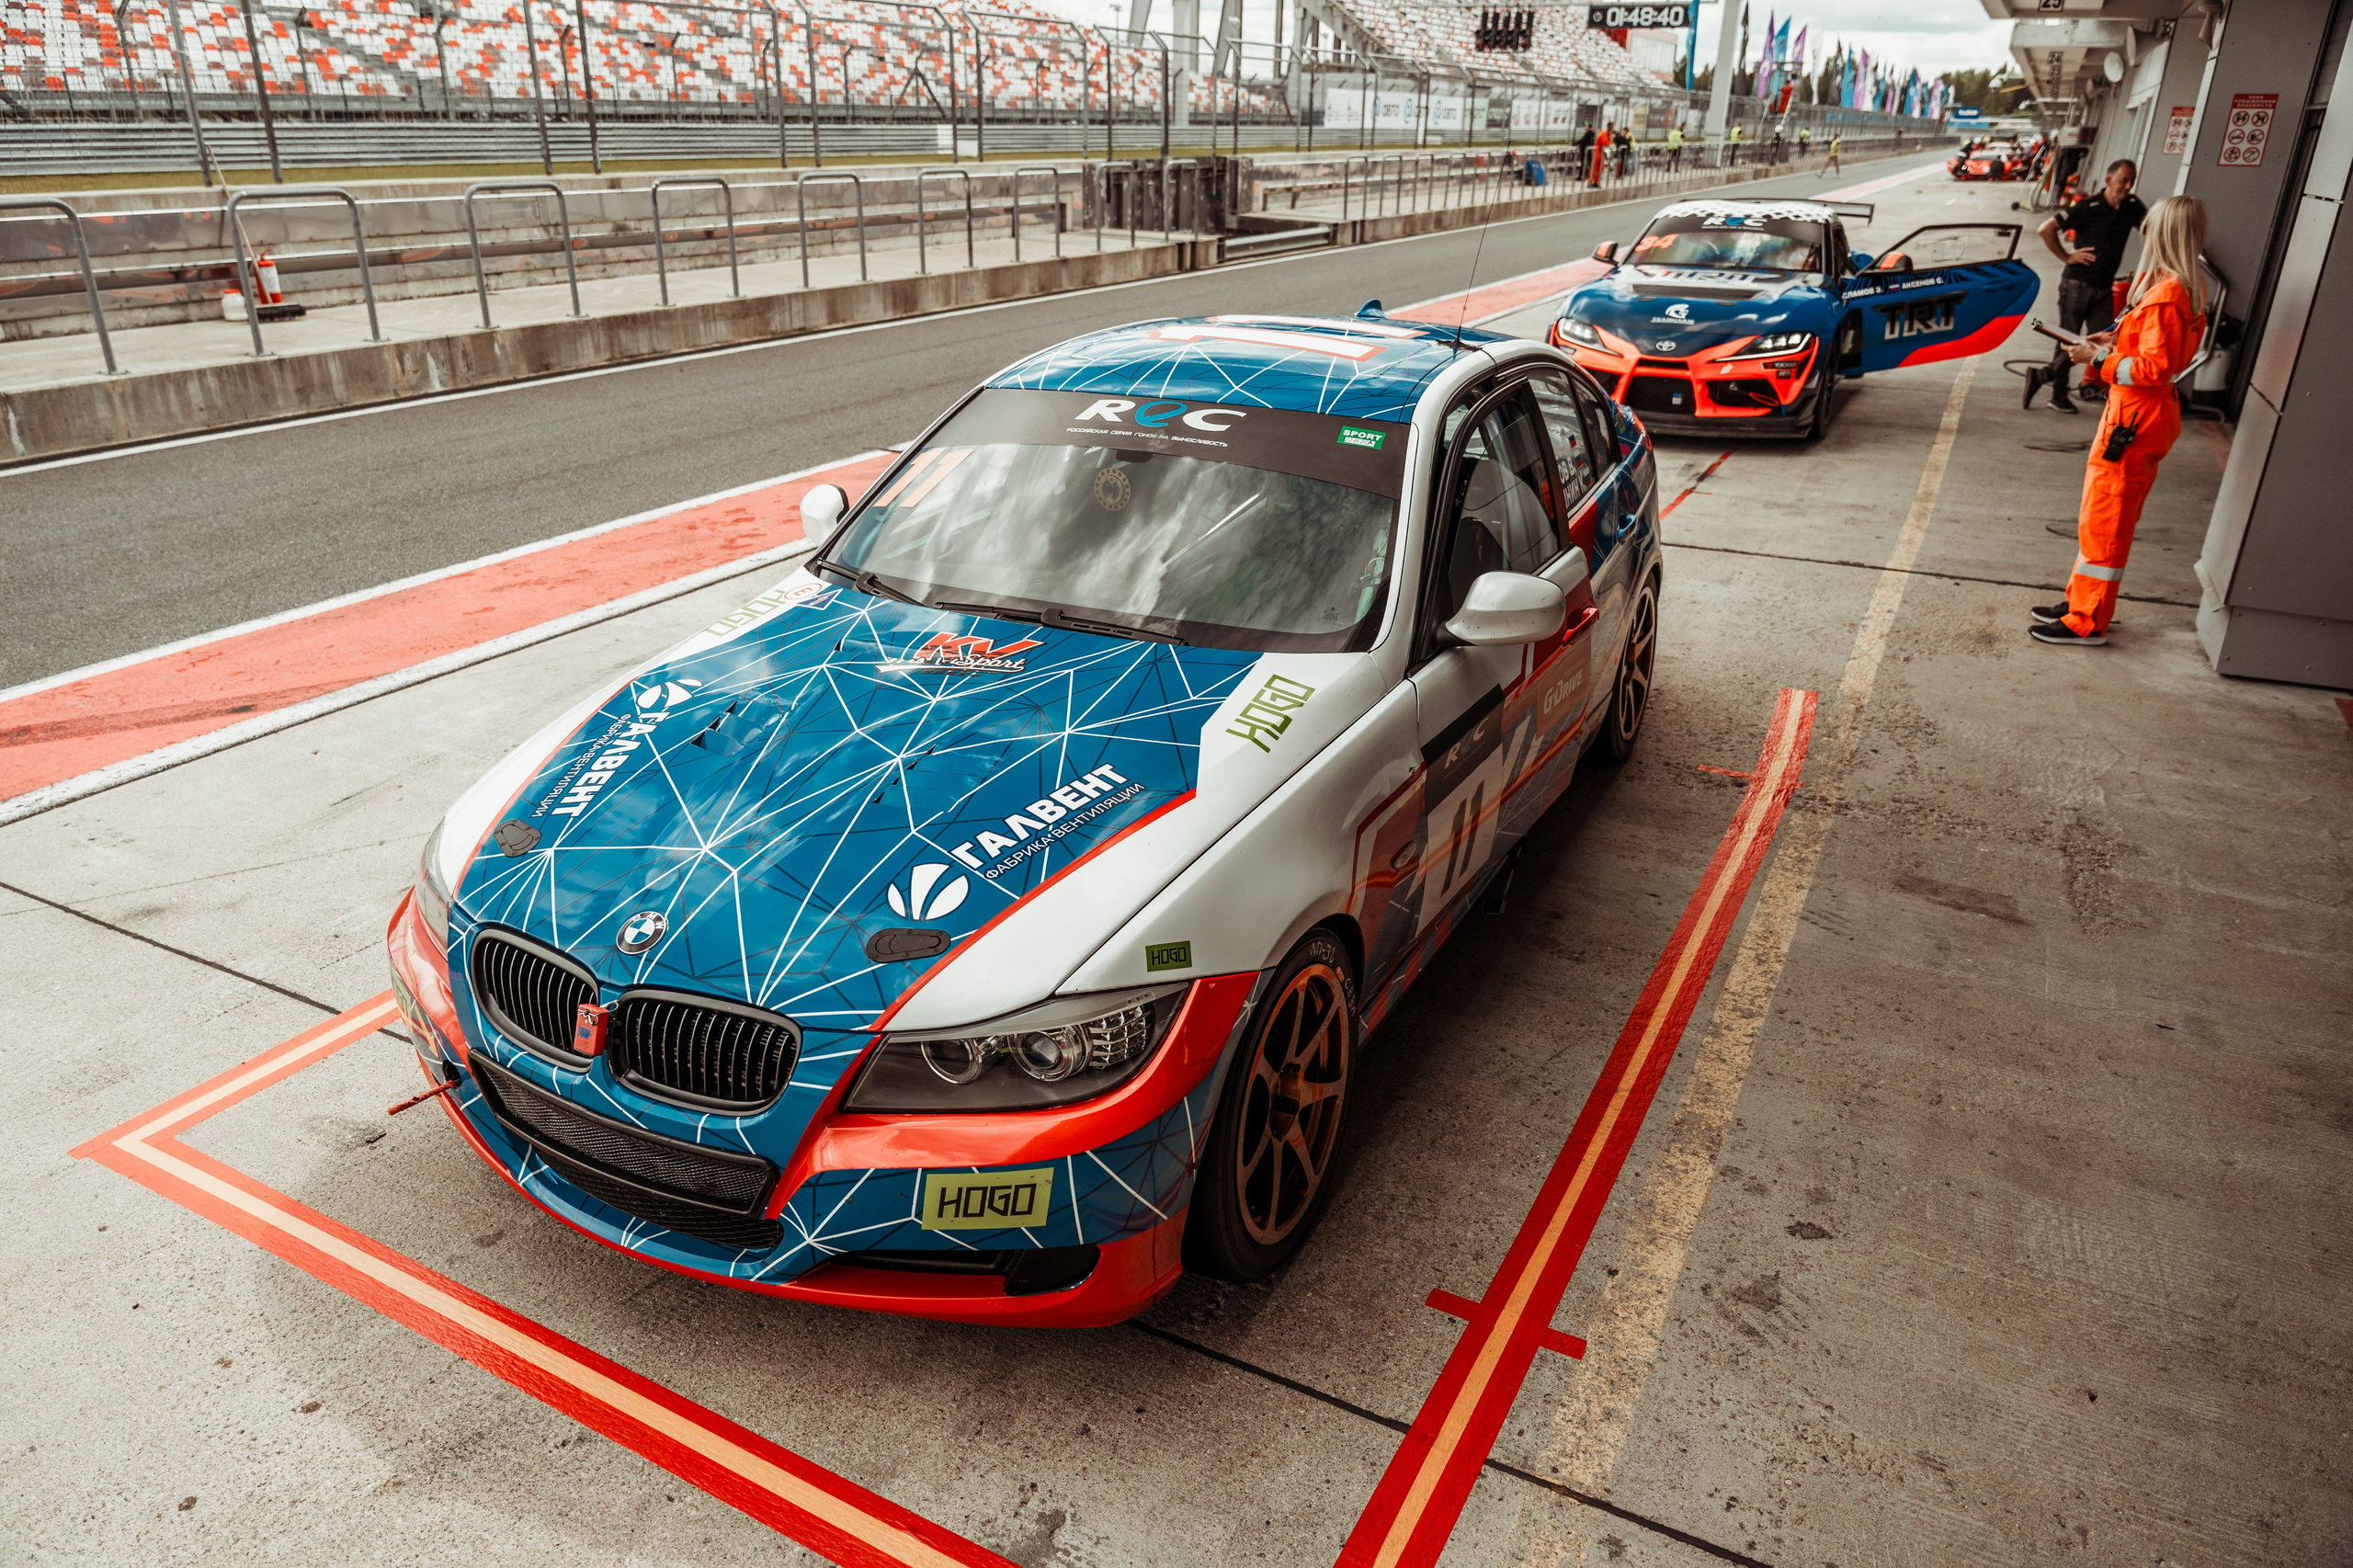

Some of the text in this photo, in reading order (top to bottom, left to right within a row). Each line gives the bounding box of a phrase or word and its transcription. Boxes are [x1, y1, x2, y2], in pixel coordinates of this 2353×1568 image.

[1606, 6, 1685, 27] 01:48:40
[1635, 233, 1678, 252] 34
[1841, 288, 1874, 300] СЛАМОВ
[1902, 278, 1936, 290] АКСЕНОВ
[1871, 290, 1969, 340] TRT
[1171, 436, 1228, 448] ВЫНОСЛИВОСТЬ
[1343, 429, 1382, 441] SPORT
[873, 448, 973, 508] 11
[1558, 460, 1570, 484] ОВ
[706, 589, 787, 637] HOGO
[914, 631, 1046, 661] KV
[962, 653, 1027, 671] Sport
[1225, 674, 1315, 754] HOGO
[530, 713, 632, 819] ФАБРИКА ВЕНТИЛЯЦИИ
[551, 711, 672, 818] ГАЛВЕНТ
[950, 763, 1128, 869] ГАЛВЕНТ
[985, 783, 1145, 880] ФАБРИКА ВЕНТИЛЯЦИИ
[1151, 947, 1187, 966] HOGO
[937, 1183, 1037, 1218] HOGO
